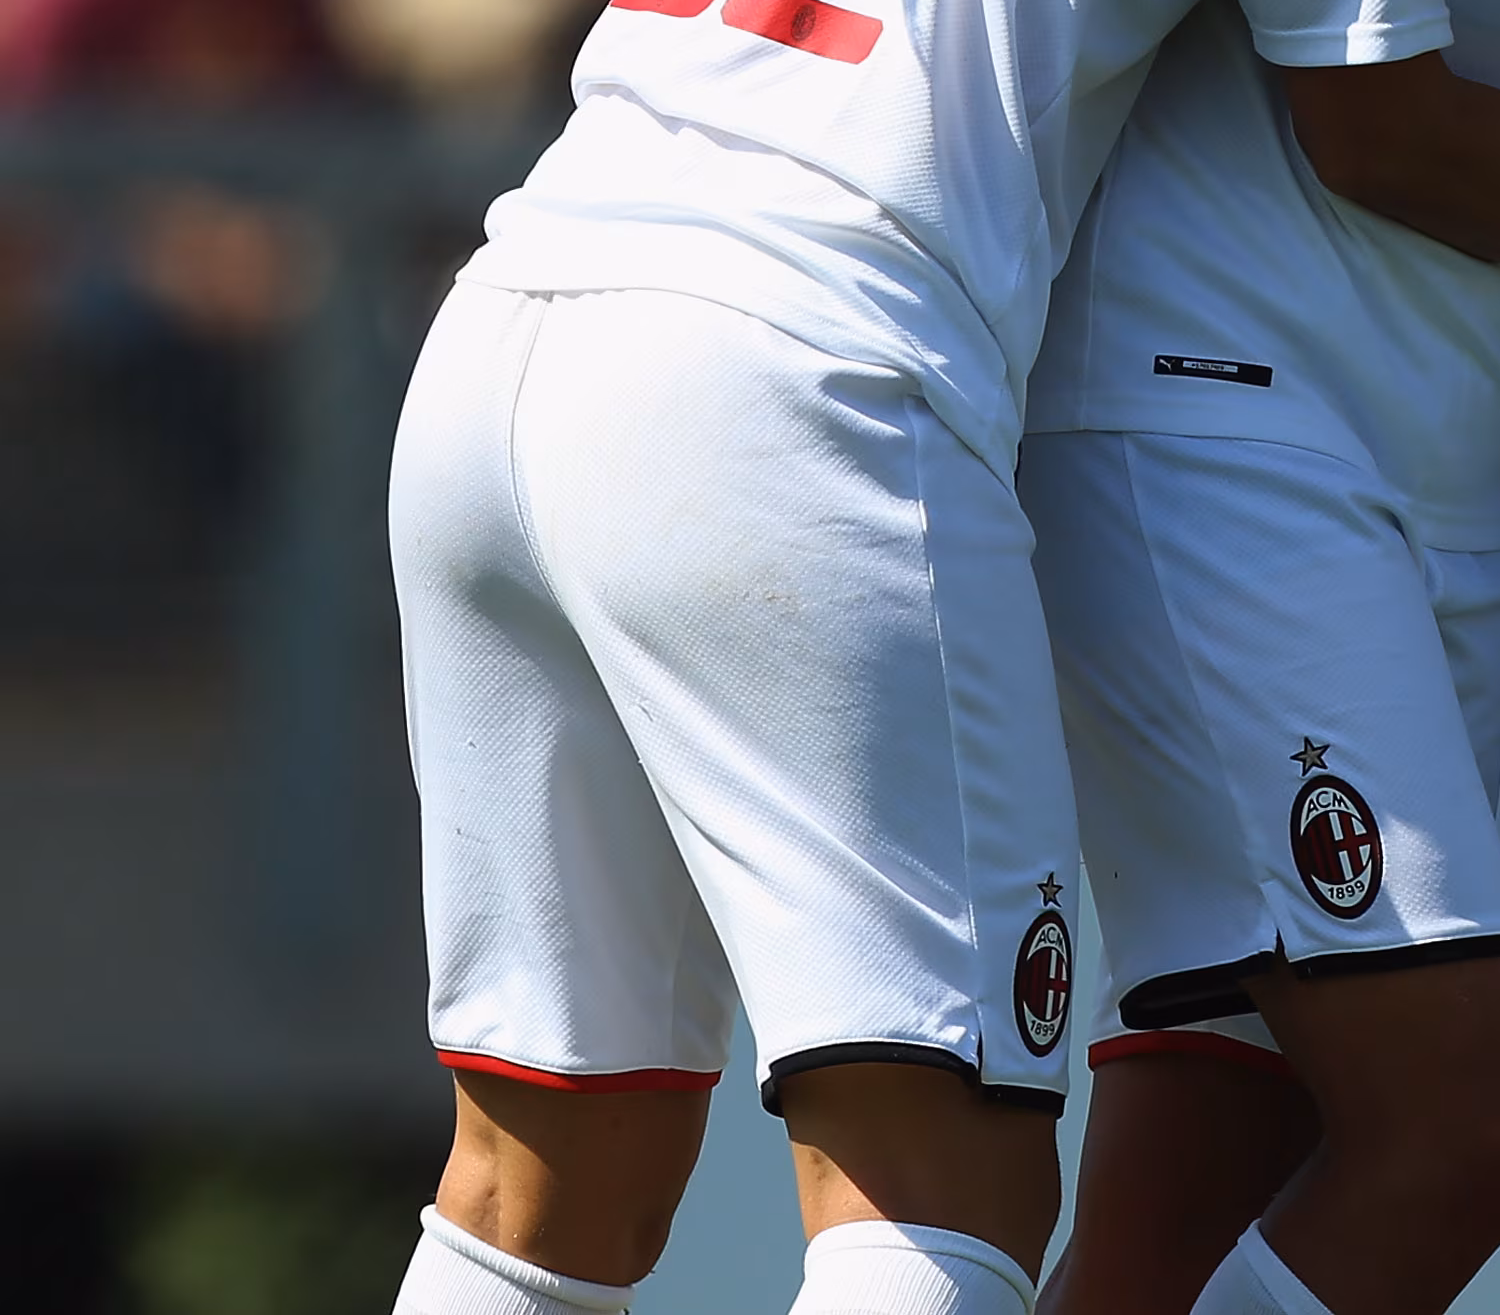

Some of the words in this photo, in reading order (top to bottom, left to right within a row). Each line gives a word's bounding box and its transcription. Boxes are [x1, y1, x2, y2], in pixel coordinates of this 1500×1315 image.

[1305, 790, 1350, 821] ACM
[1327, 880, 1366, 900] 1899
[1035, 926, 1066, 953] ACM
[1030, 1019, 1056, 1037] 1899
